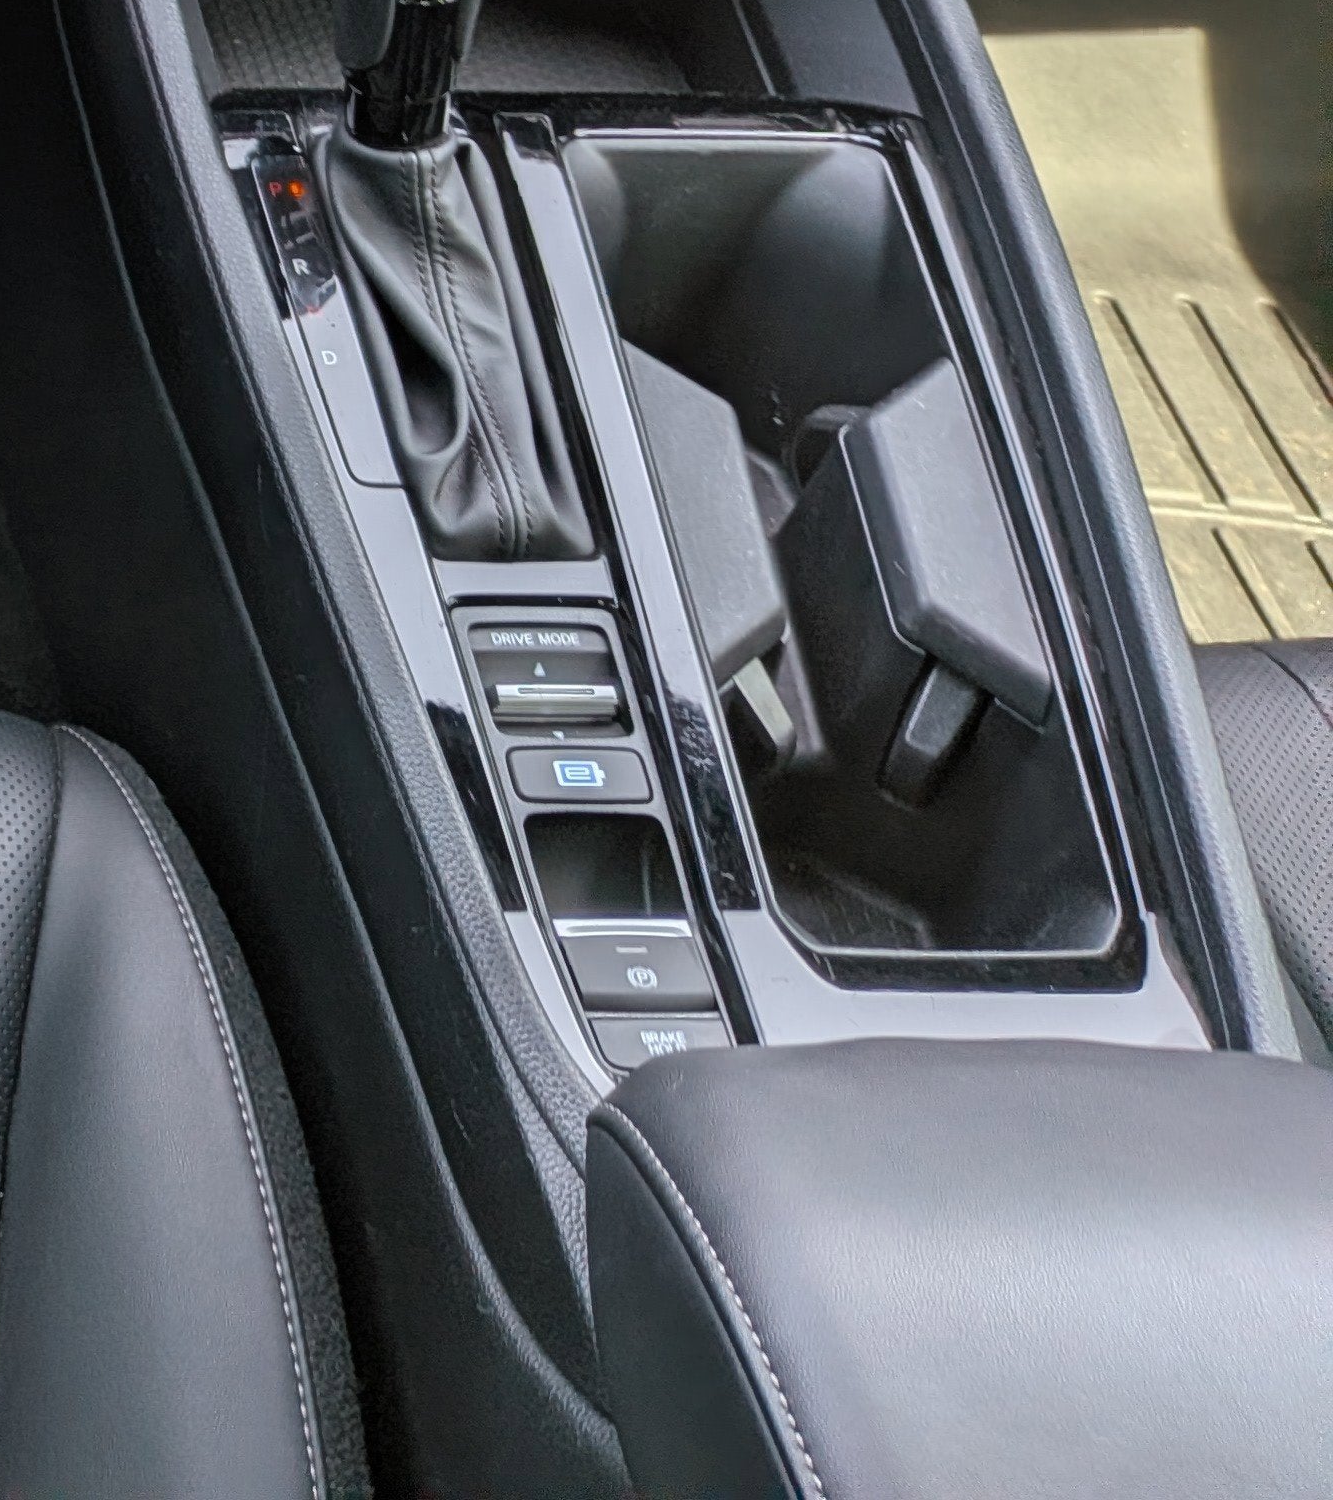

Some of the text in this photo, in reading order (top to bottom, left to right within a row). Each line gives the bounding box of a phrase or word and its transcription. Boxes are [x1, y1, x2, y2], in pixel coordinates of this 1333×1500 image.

[292, 257, 310, 276] R
[321, 350, 337, 366] D
[491, 632, 582, 646] DRIVE MODE
[640, 1029, 687, 1045] BRAKE
